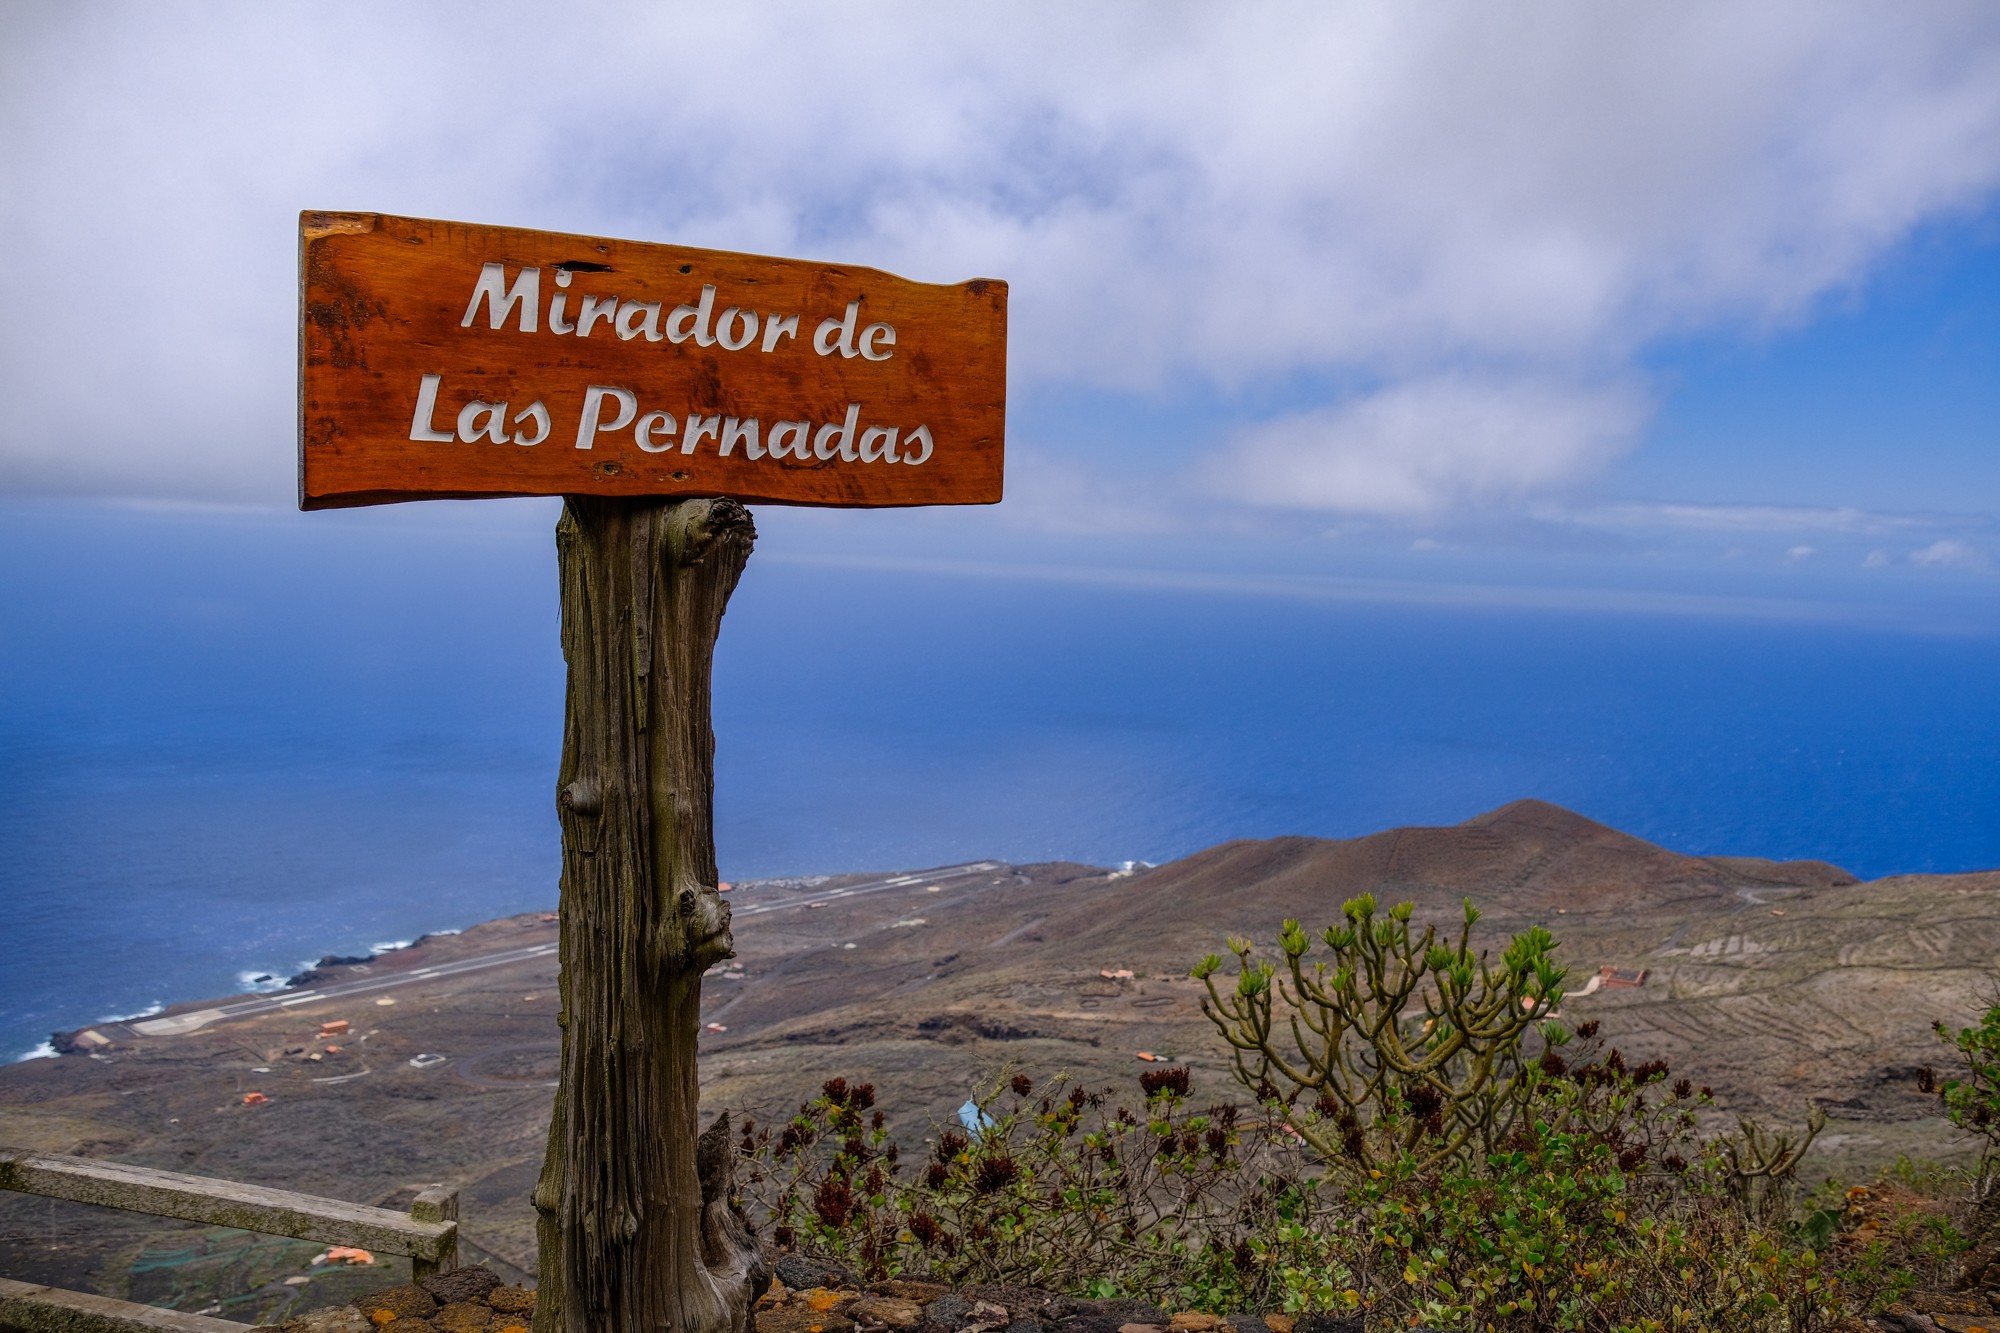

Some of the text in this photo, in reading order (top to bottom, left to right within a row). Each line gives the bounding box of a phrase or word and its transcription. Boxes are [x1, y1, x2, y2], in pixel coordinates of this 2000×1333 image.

[460, 263, 896, 361] Mirador de
[409, 375, 934, 465] Las Pernadas
